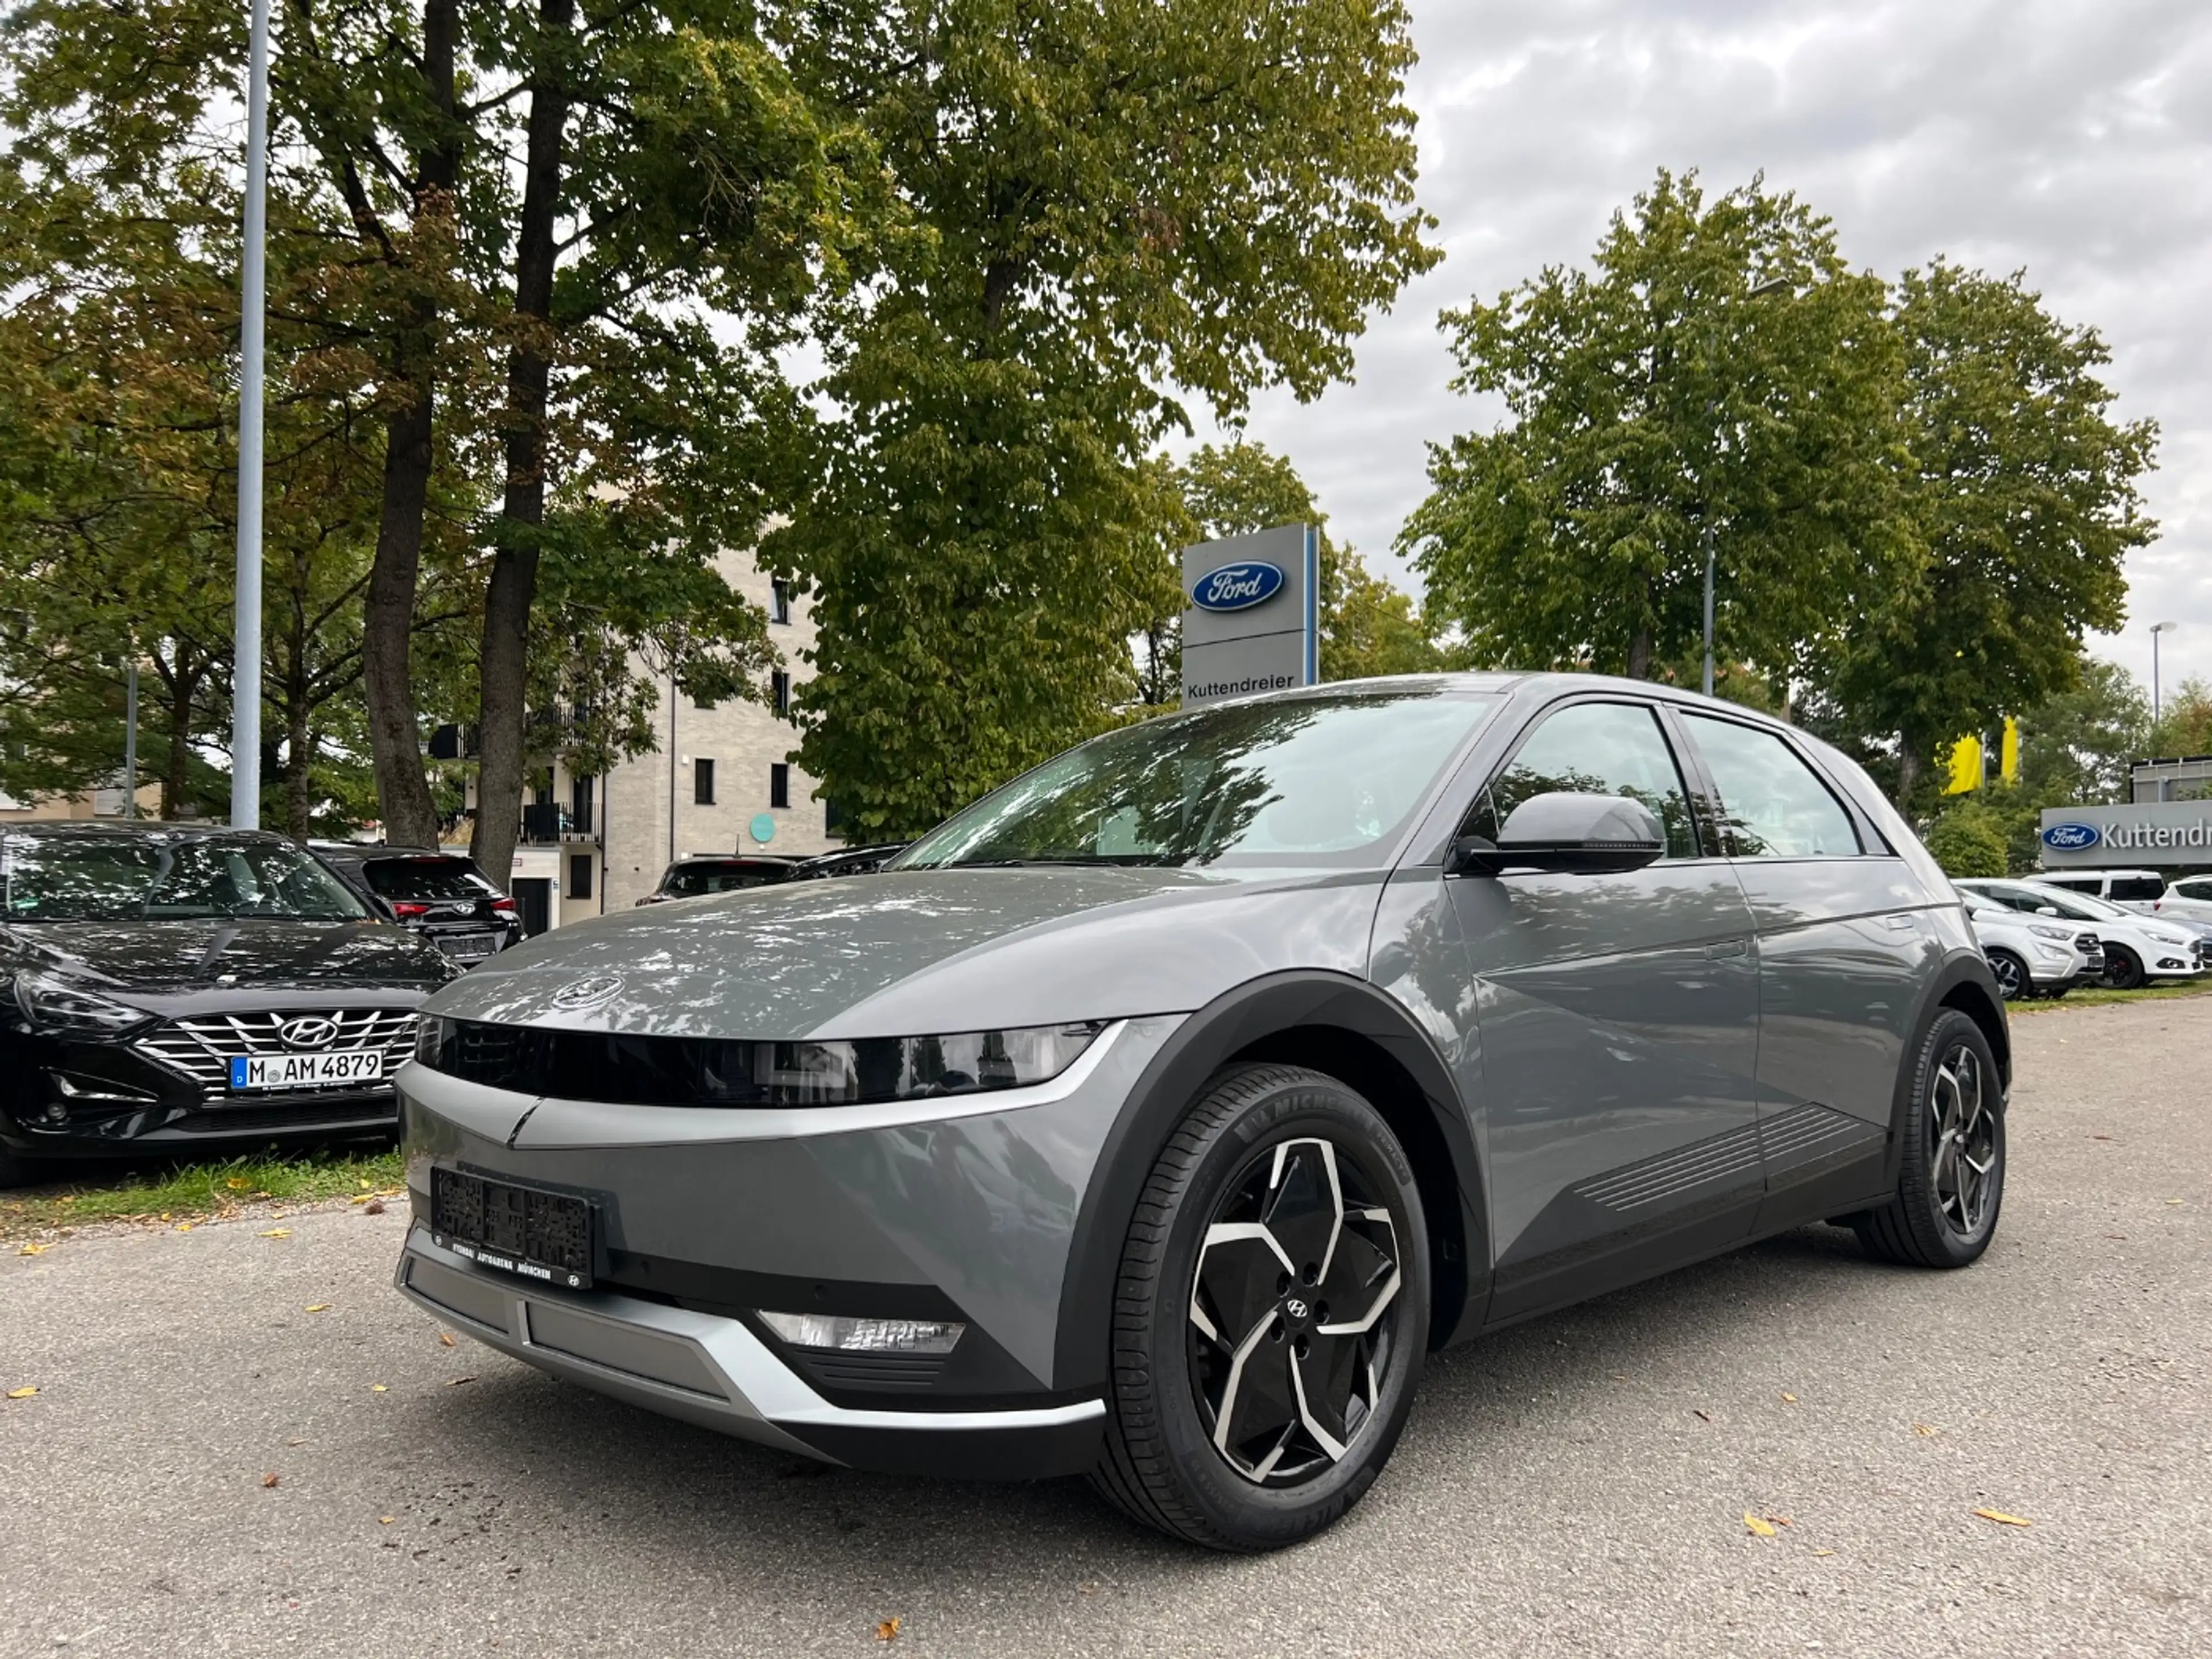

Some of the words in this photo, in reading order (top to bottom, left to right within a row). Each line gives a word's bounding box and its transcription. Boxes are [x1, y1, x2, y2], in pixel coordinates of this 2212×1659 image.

[1207, 569, 1263, 603] Ford
[1188, 675, 1294, 699] Kuttendreier
[2051, 827, 2085, 844] Ford
[249, 1060, 265, 1084] M
[284, 1058, 315, 1081] AM
[321, 1054, 378, 1078] 4879
[517, 1262, 551, 1280] MÜNCHEN
